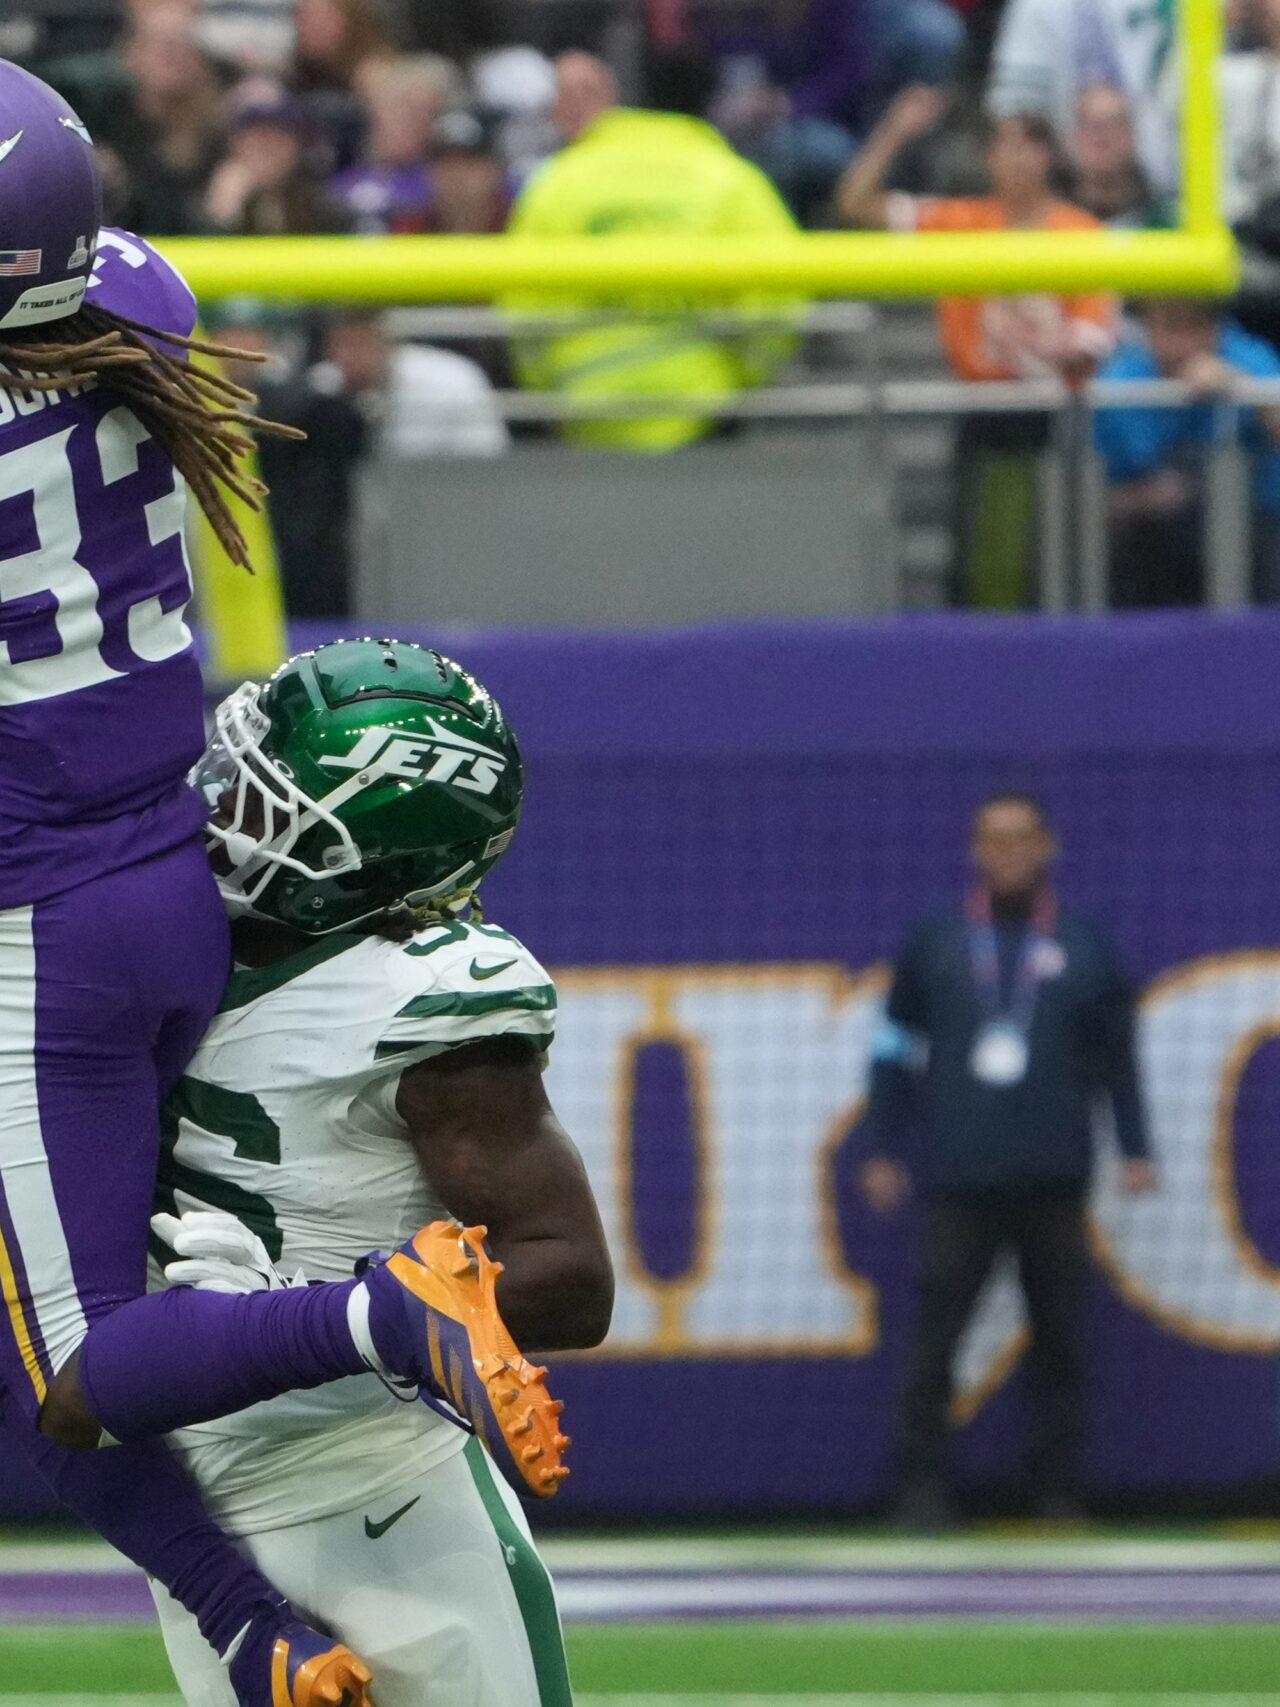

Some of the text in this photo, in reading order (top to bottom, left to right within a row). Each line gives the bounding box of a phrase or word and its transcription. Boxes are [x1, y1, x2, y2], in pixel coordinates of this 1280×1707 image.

[19, 301, 29, 310] IT
[54, 296, 69, 306] ALL
[317, 714, 508, 796] JETS
